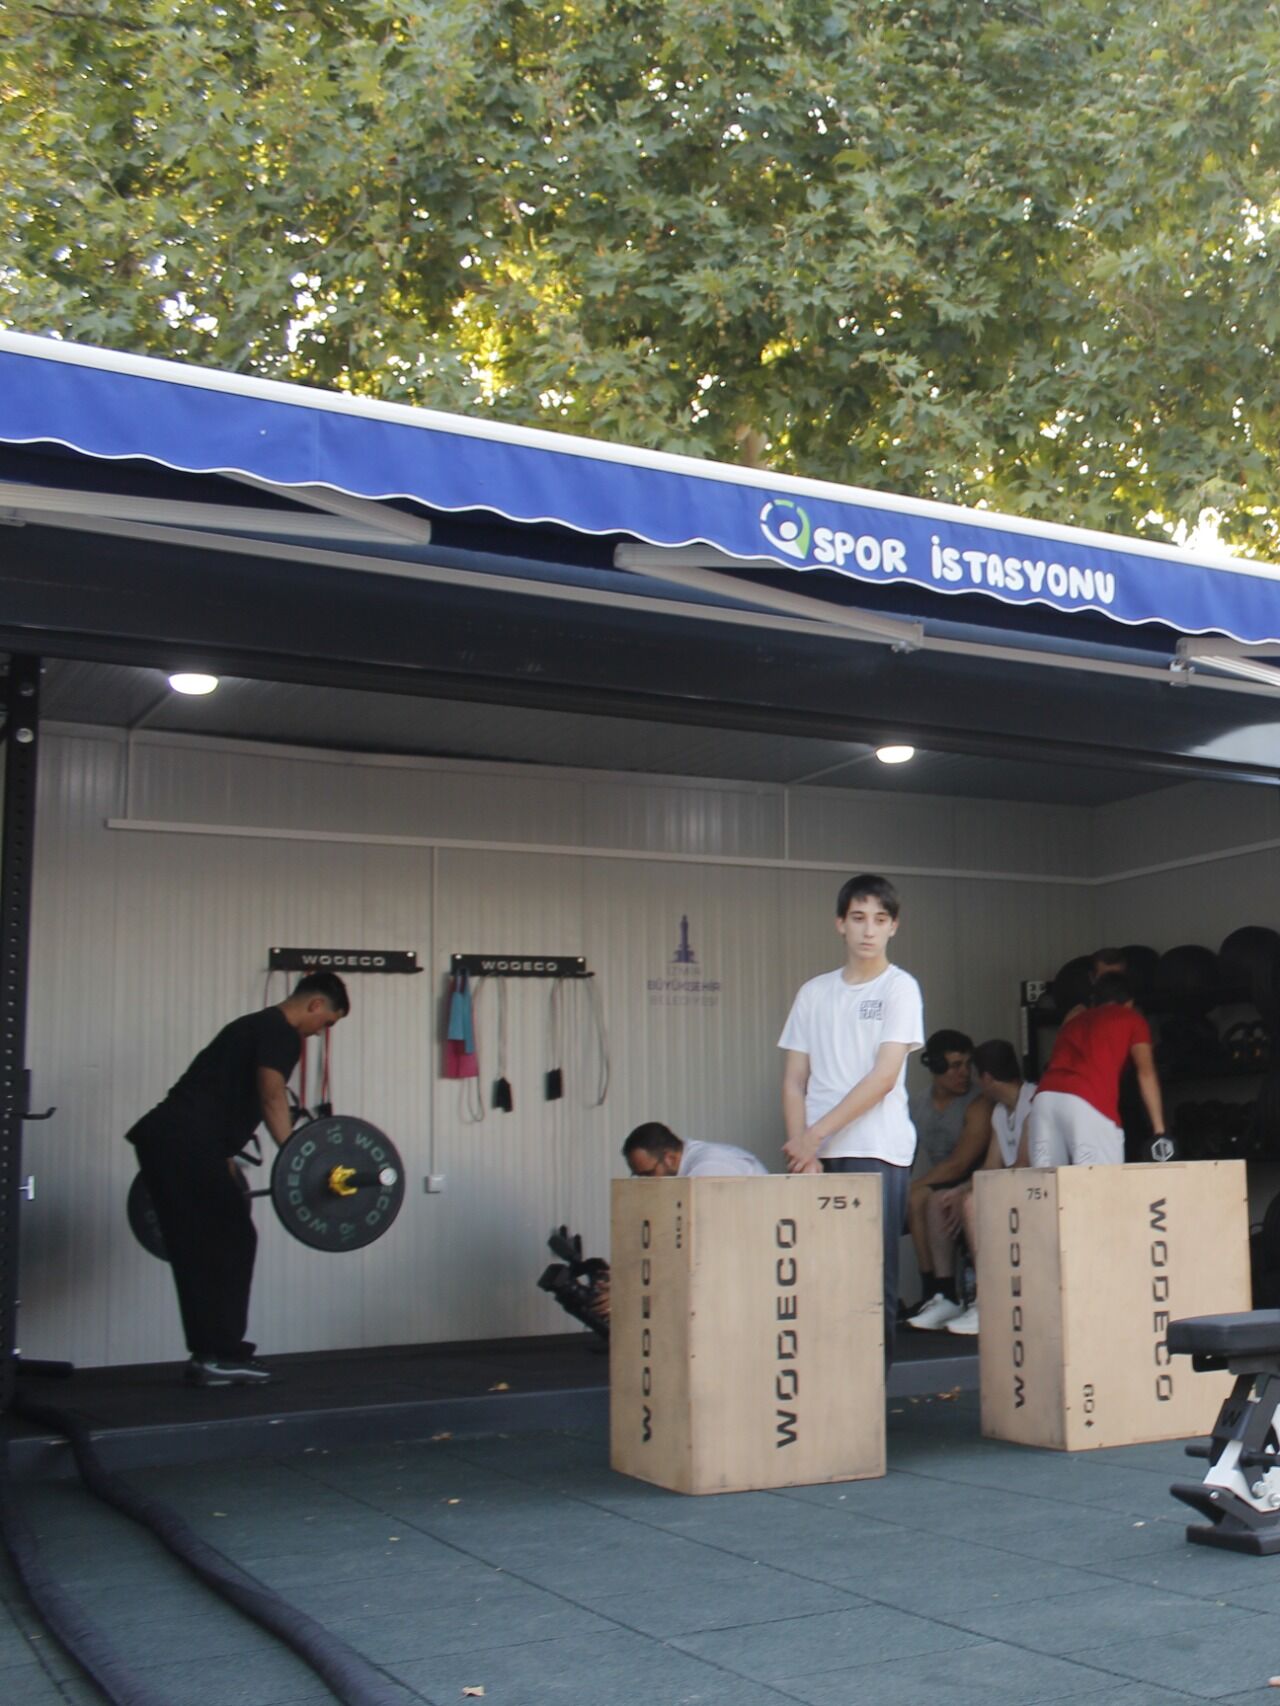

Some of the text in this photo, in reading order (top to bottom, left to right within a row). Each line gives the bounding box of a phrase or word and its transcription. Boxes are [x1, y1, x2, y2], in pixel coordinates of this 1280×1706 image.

[813, 527, 906, 573] SPOR
[302, 955, 386, 966] WODECO
[482, 960, 558, 972] WODECO
[288, 1140, 328, 1235] WODECO
[776, 1218, 799, 1448] WODECO
[1008, 1207, 1026, 1409] WODECO
[1149, 1198, 1173, 1403] WODECO
